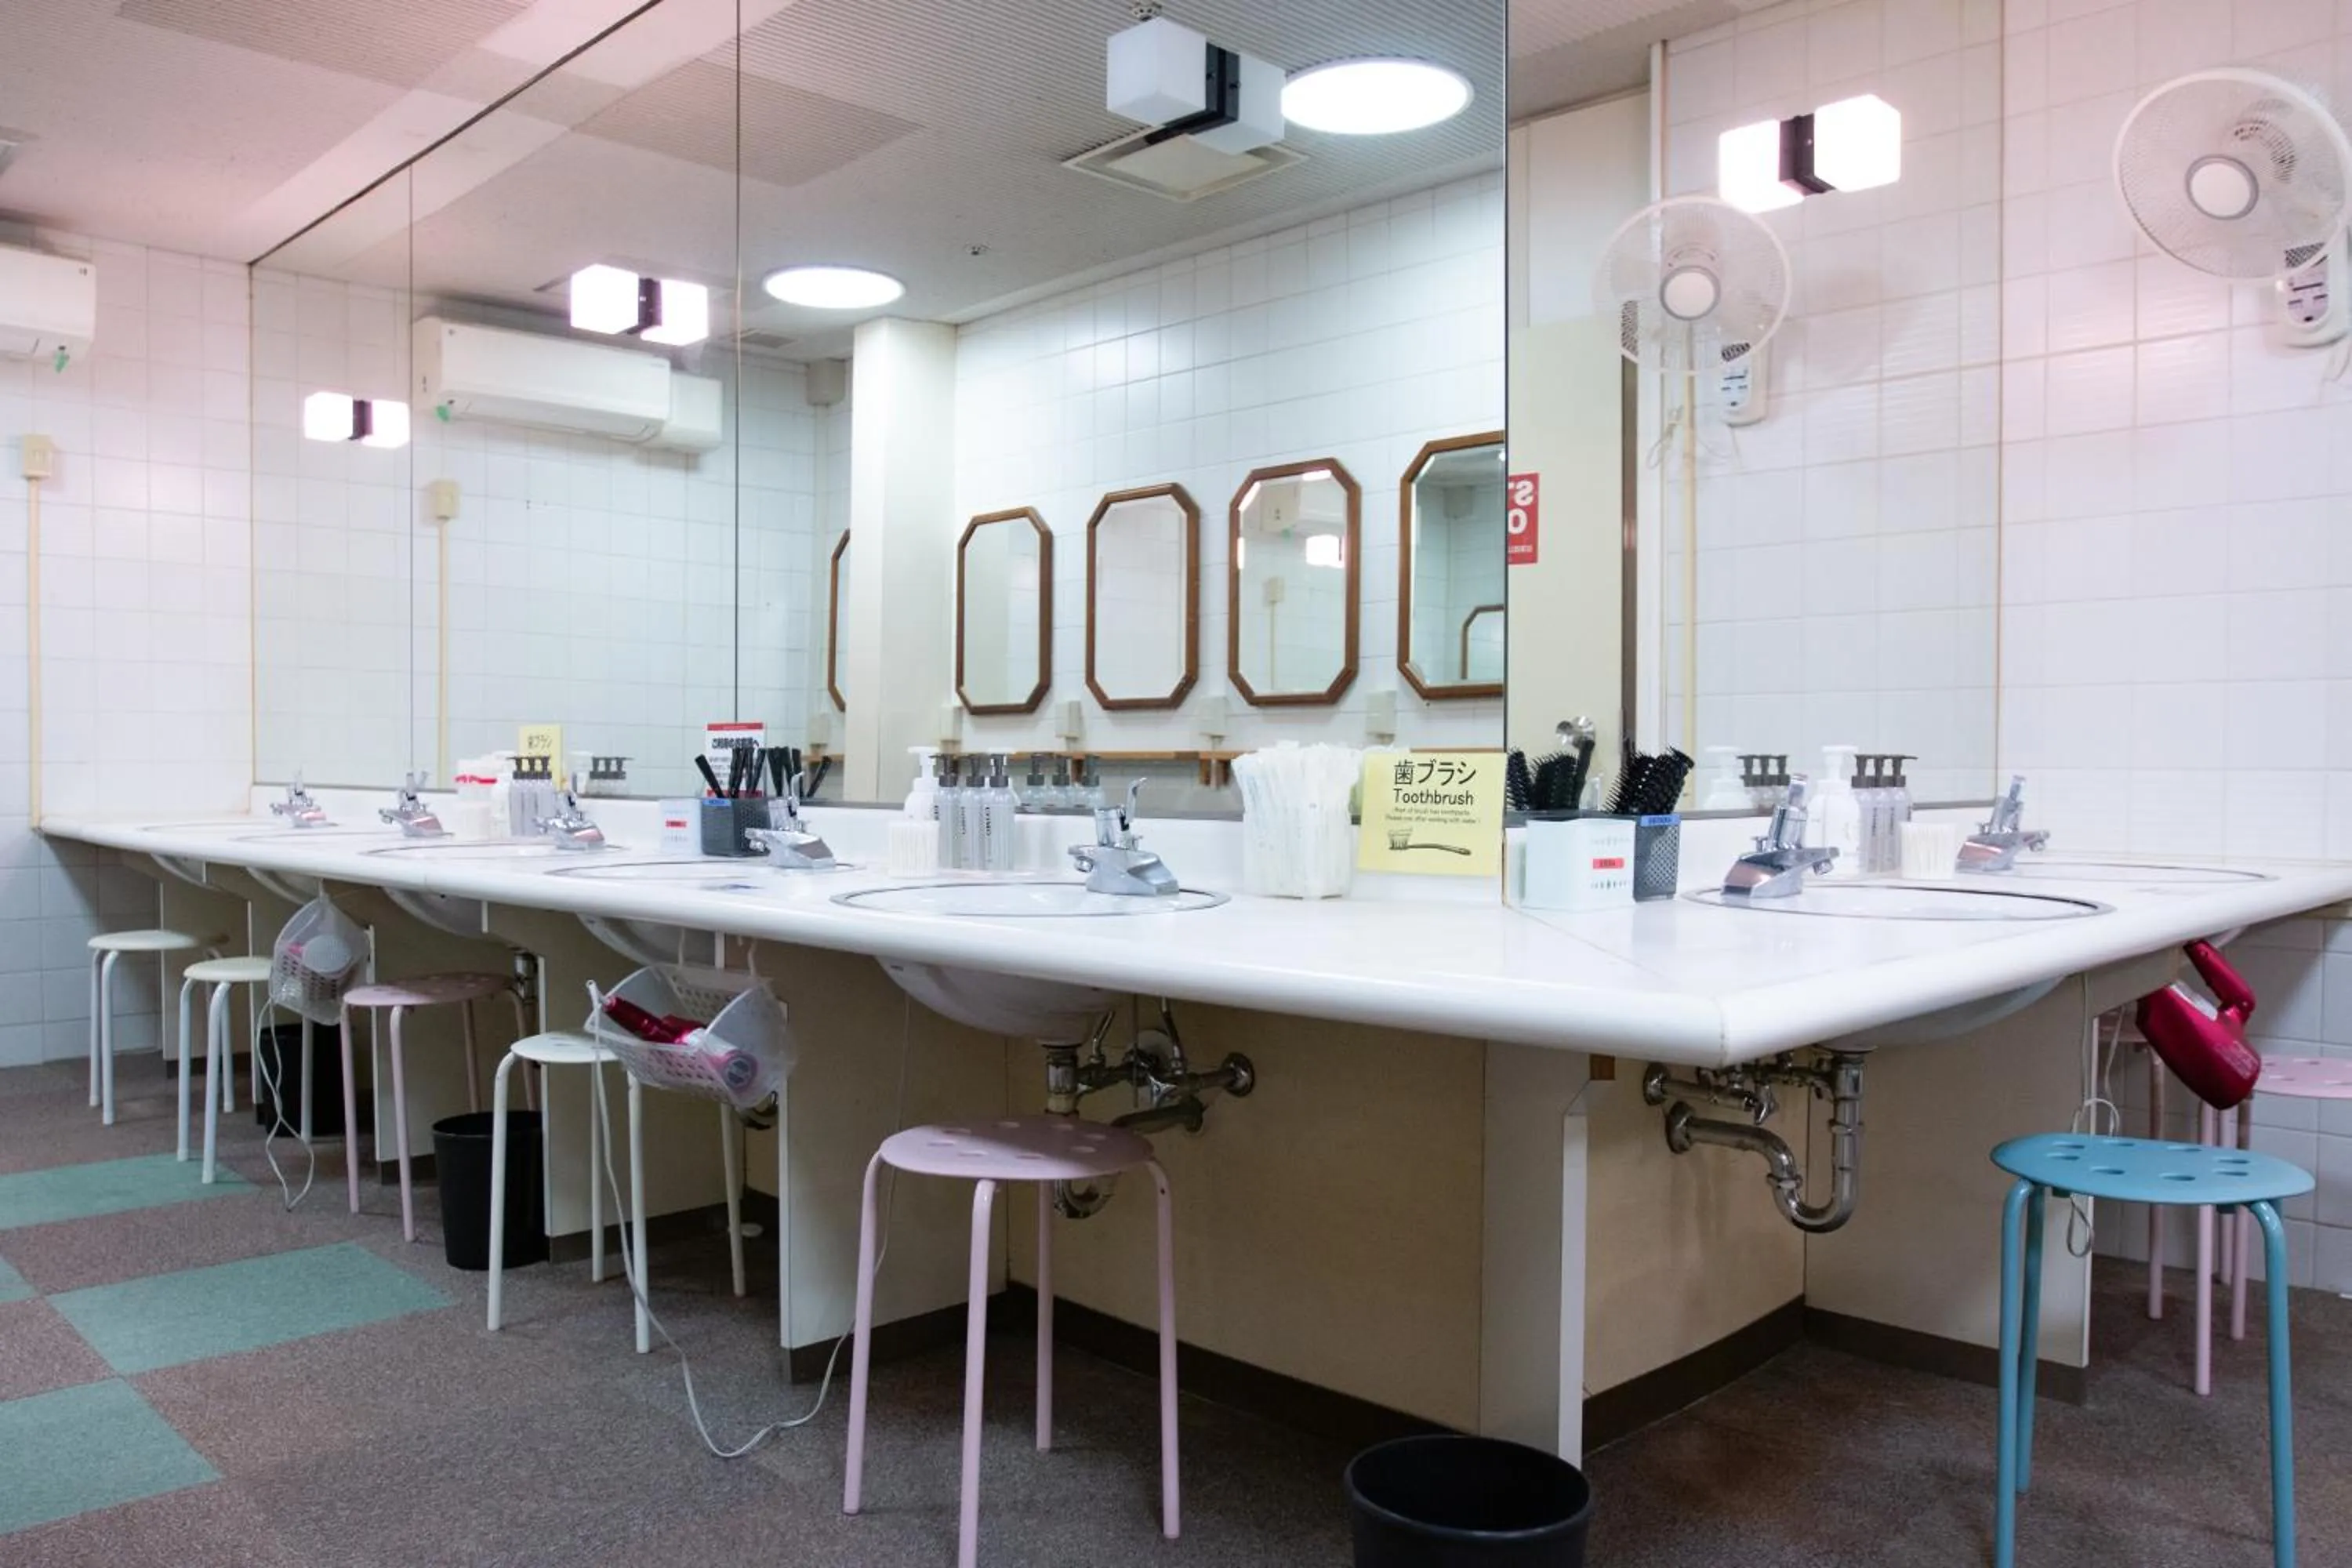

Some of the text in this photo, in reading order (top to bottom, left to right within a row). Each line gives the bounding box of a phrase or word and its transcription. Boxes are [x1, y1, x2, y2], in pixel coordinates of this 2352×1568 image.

[1394, 759, 1476, 786] 歯ブラシ
[1393, 788, 1474, 805] Toothbrush
